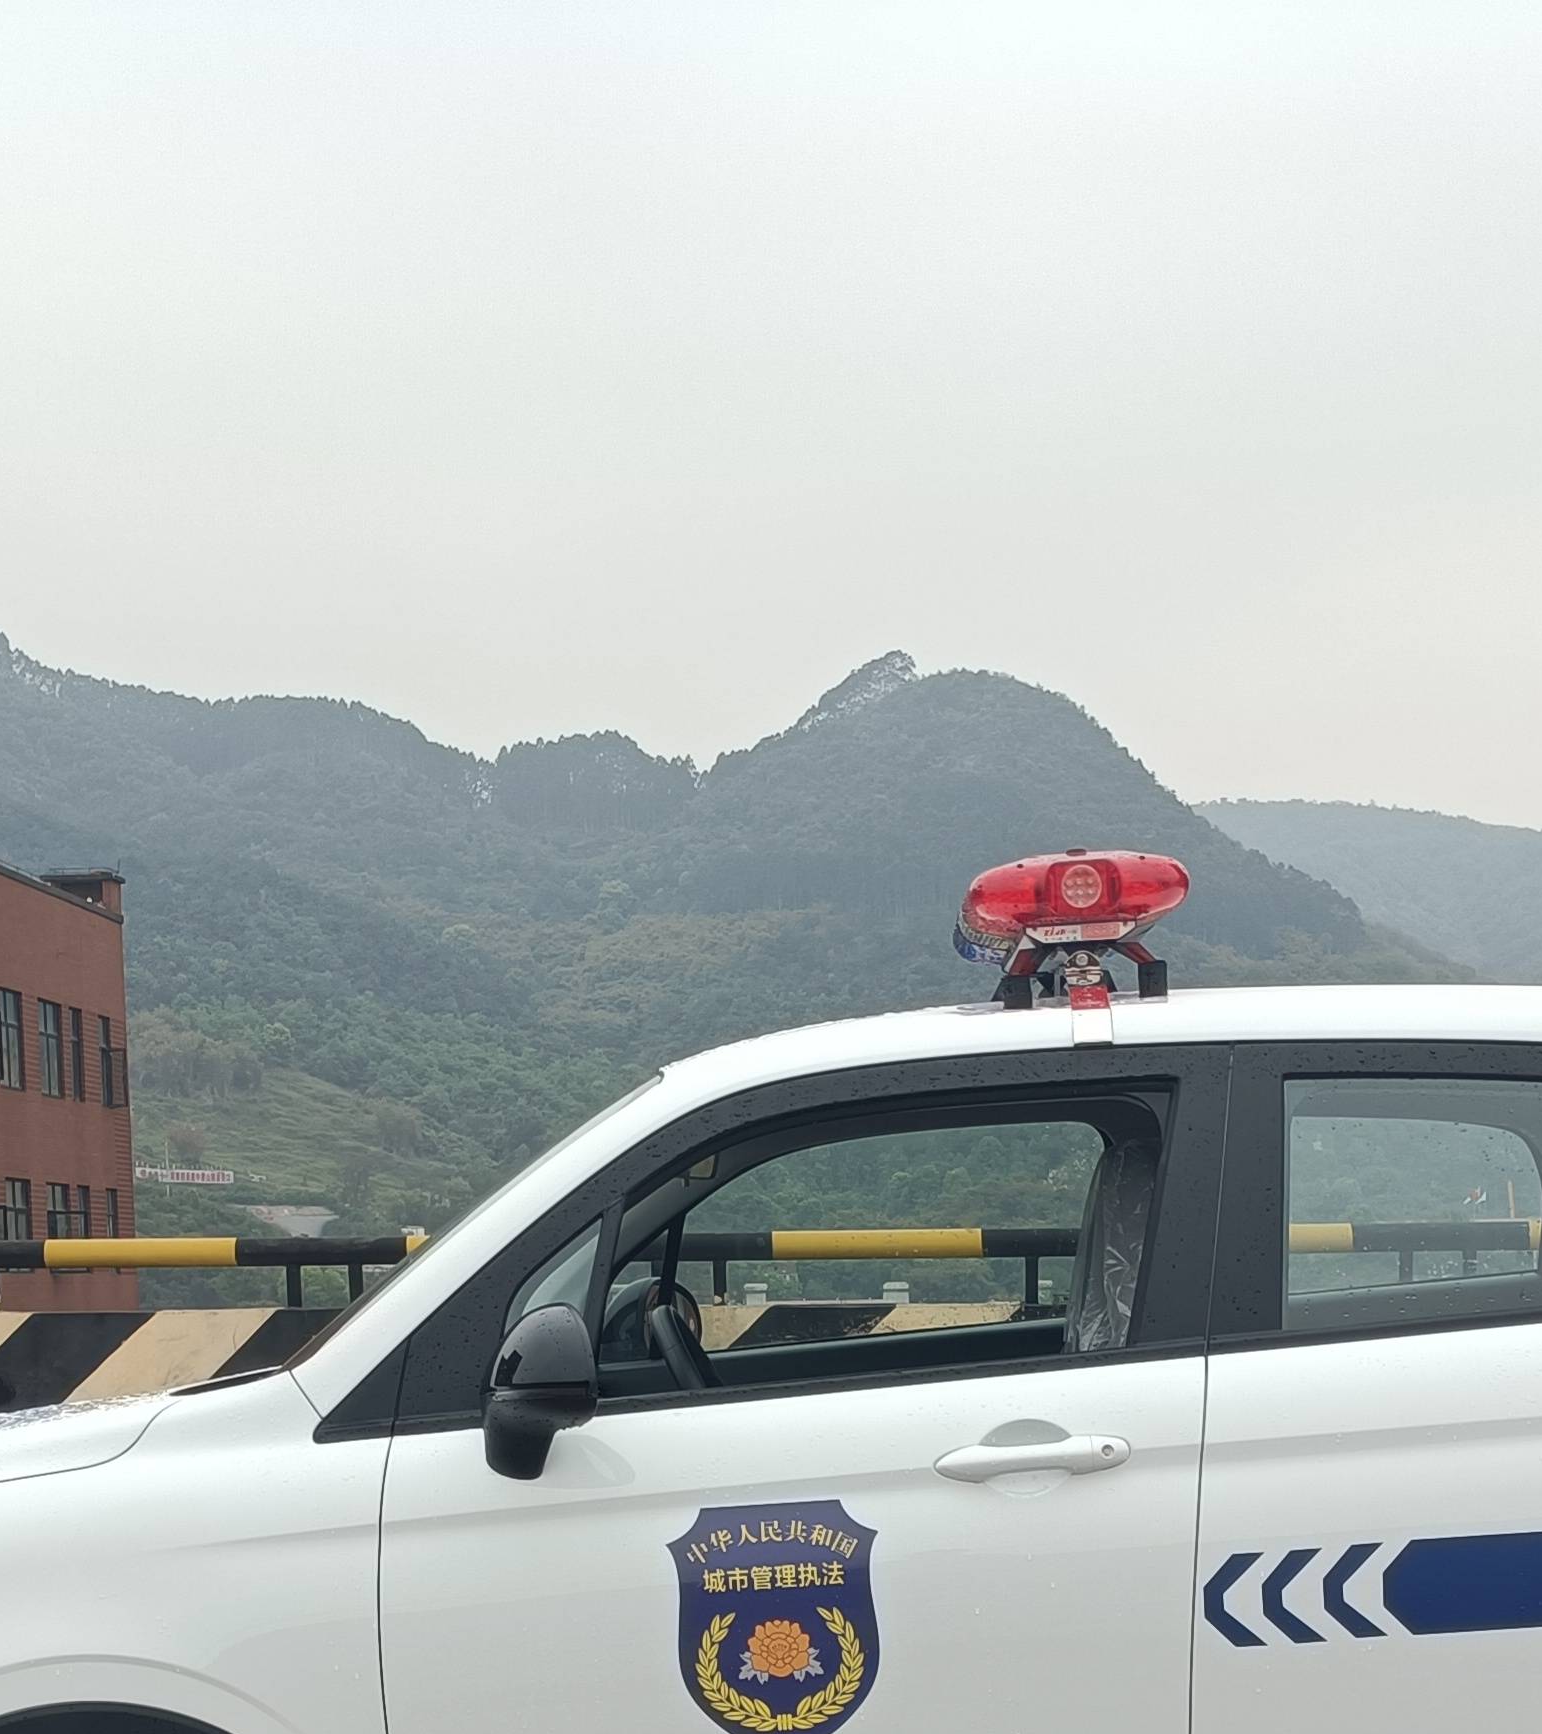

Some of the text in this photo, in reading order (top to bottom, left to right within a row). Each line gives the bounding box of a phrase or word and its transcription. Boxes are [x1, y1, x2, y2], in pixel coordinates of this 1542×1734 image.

[686, 1520, 858, 1564] 中华人民共和国
[702, 1561, 845, 1593] 城市管理执法
